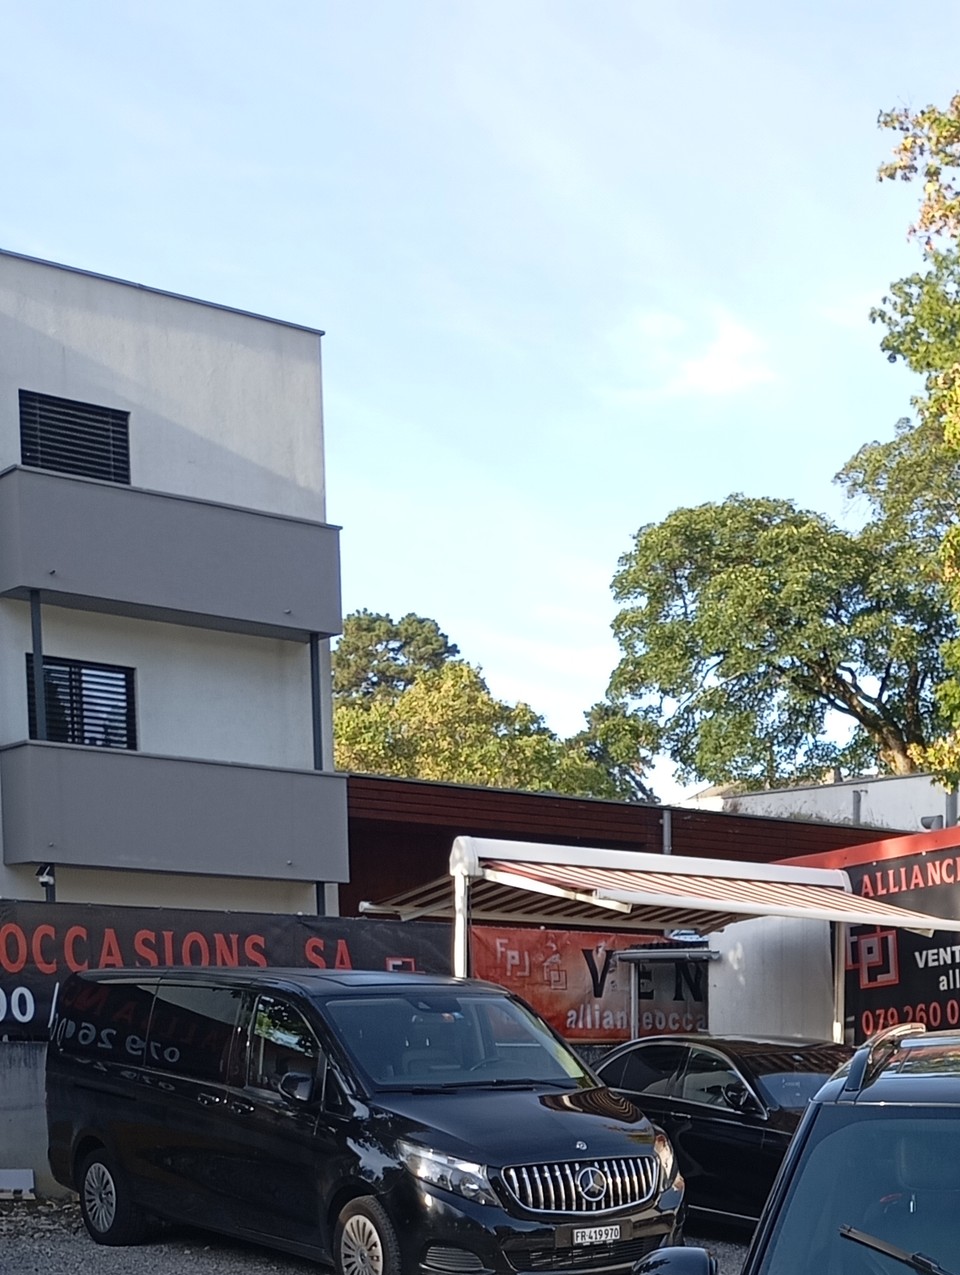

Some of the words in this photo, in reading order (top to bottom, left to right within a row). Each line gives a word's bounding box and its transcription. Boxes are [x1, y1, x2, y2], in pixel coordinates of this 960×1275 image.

[0, 923, 269, 974] OCCASIONS
[305, 937, 353, 970] SA
[567, 1004, 708, 1032] allianeocca
